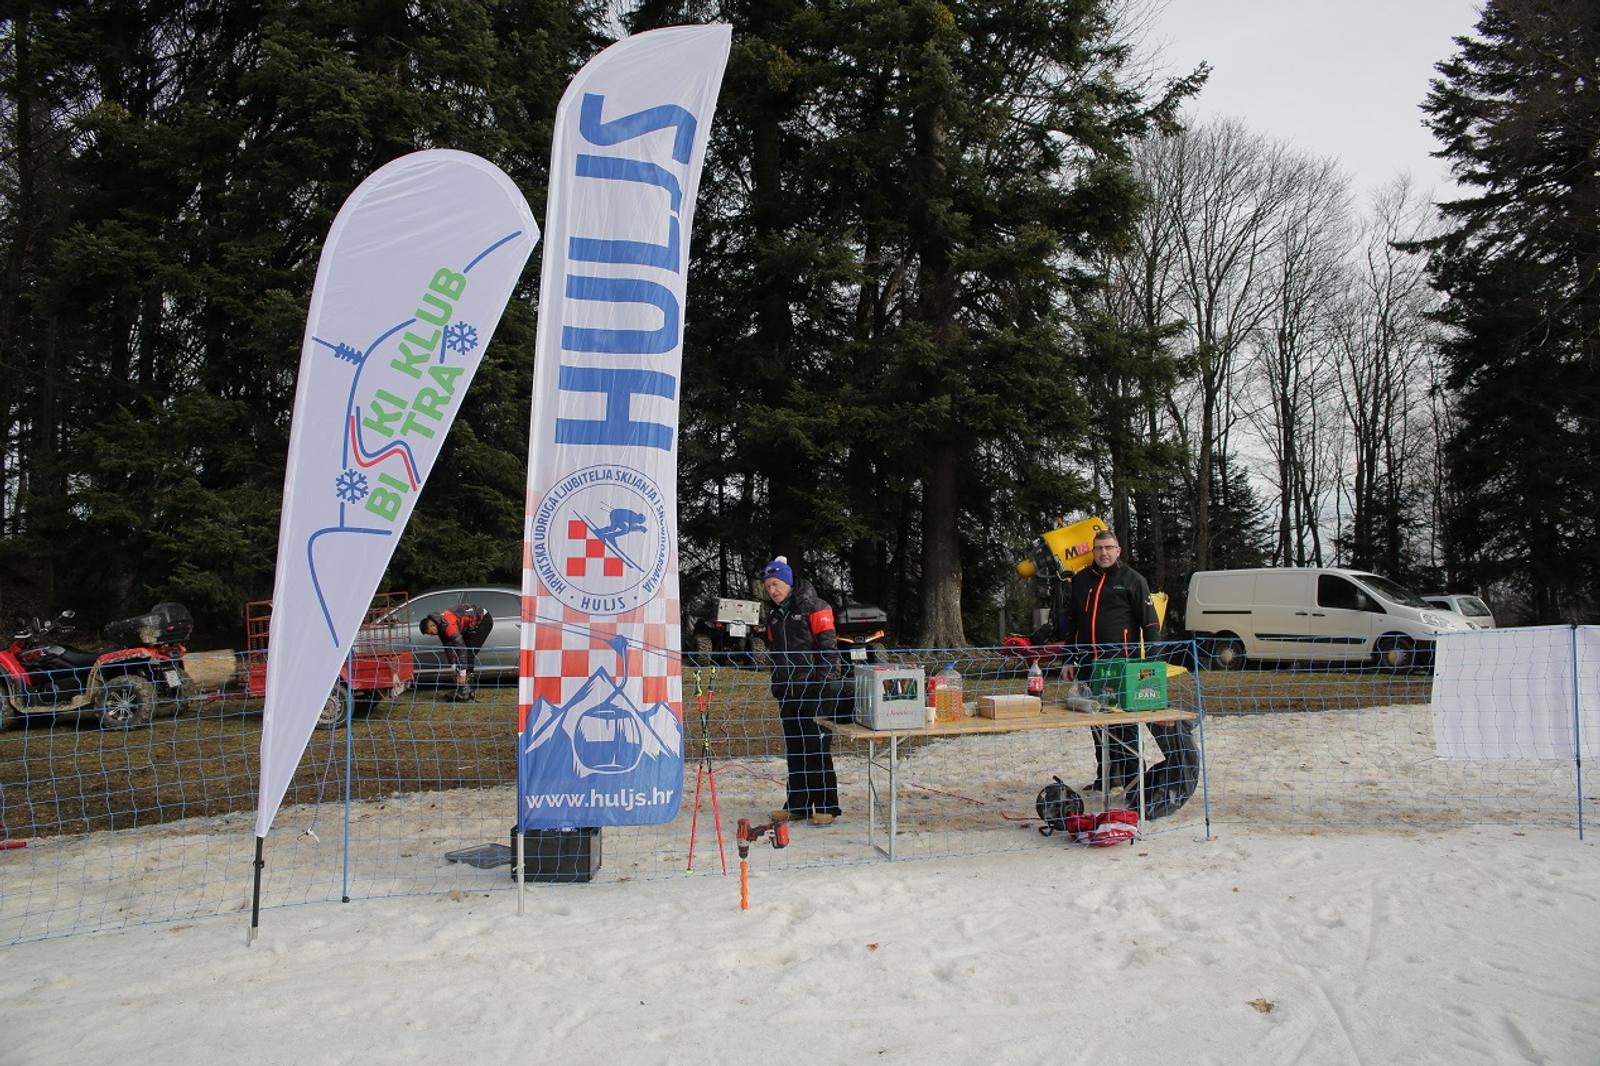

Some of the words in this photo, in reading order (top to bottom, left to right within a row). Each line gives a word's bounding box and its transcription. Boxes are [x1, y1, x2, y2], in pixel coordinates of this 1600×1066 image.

[554, 92, 698, 452] HULJS
[390, 267, 467, 380] KLUB
[555, 469, 613, 500] LJUBITELJA
[615, 470, 658, 502] SKIJANJA
[534, 496, 559, 541] UDRUGA
[534, 543, 567, 594] HRVATSKA
[580, 596, 626, 611] HULJS
[526, 787, 674, 811] www.huljs.hr
